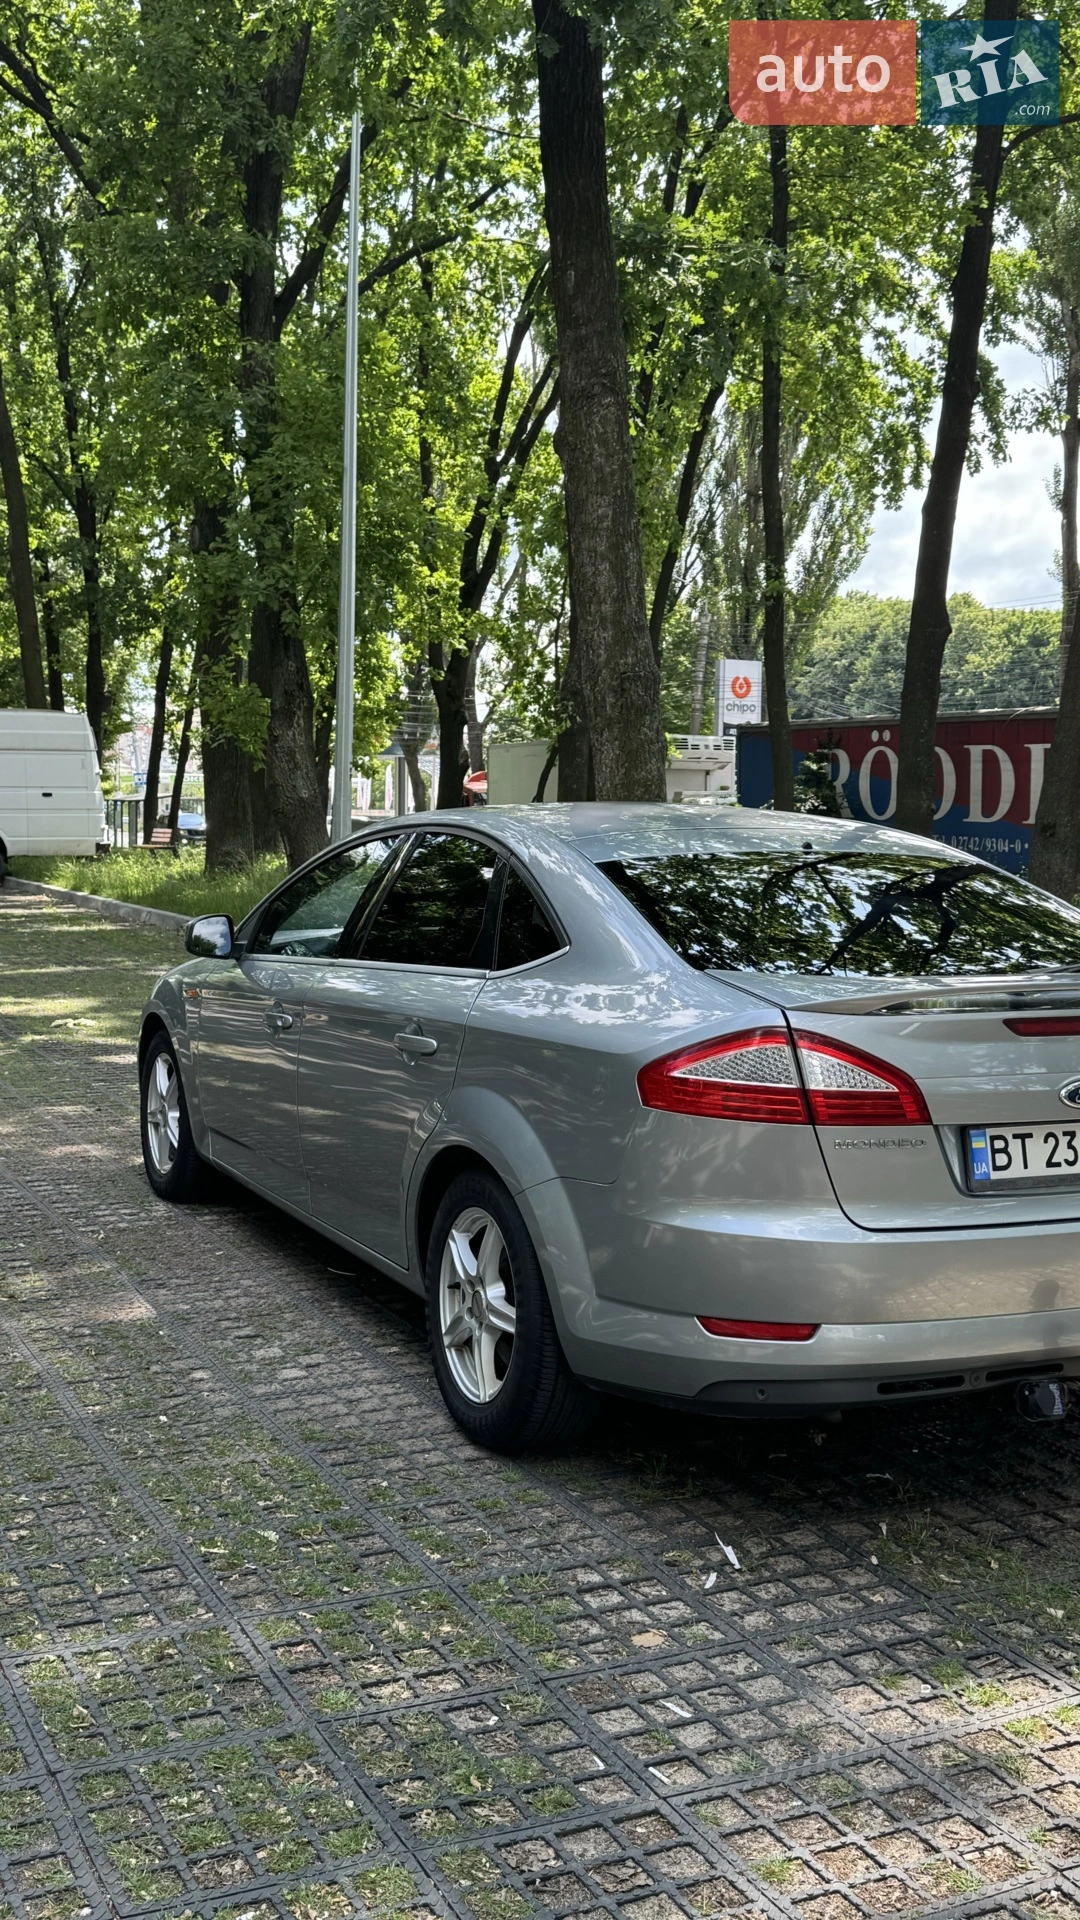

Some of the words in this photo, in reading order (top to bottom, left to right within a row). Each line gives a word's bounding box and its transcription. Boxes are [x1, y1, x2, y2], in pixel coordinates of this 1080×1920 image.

[725, 701, 757, 714] chipo
[951, 835, 1022, 854] 02742/9304-0
[833, 1137, 928, 1150] MONDEO
[988, 1132, 1034, 1172] BT
[1043, 1130, 1079, 1168] 23
[973, 1161, 989, 1174] UA
